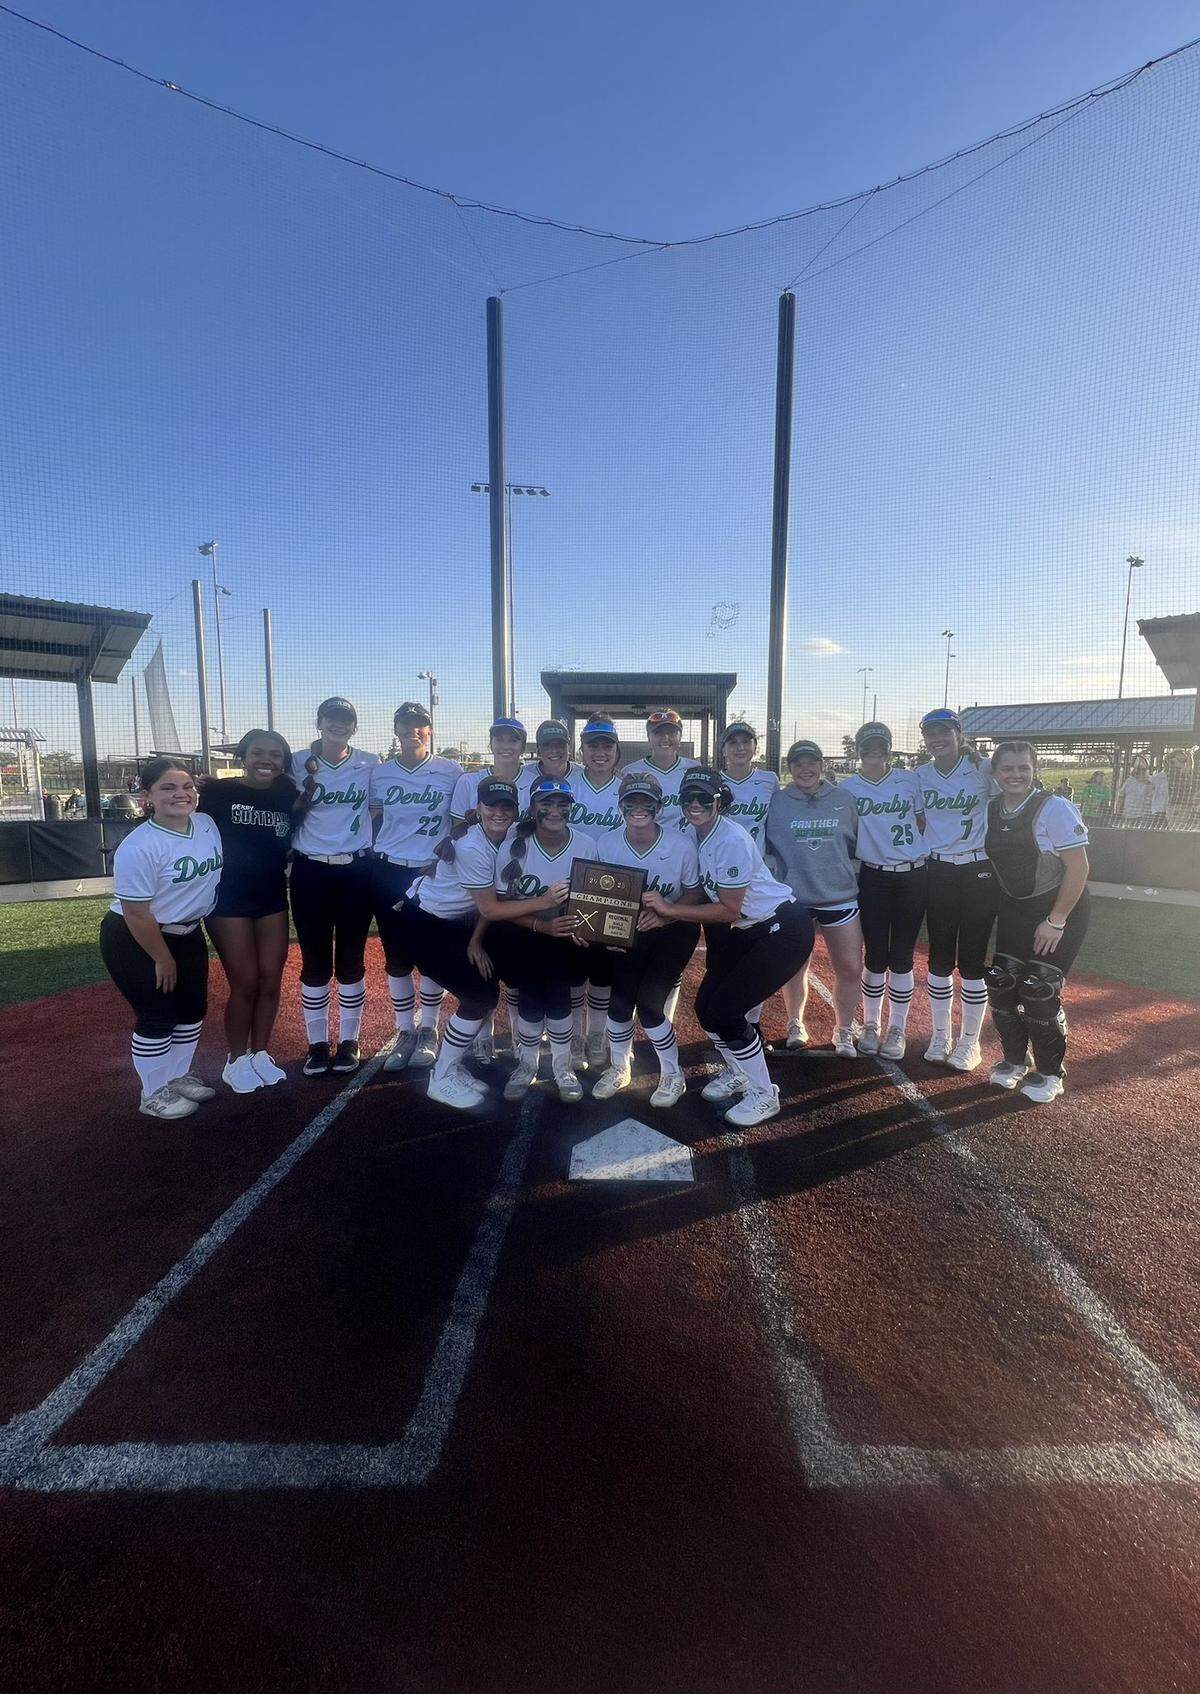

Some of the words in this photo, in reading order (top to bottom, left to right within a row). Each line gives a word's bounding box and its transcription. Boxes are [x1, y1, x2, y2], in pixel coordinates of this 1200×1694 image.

[310, 782, 368, 811] Derby
[383, 784, 444, 812] Derby
[489, 783, 514, 794] DERBY
[231, 803, 255, 812] DERBY
[727, 796, 769, 822] erby
[856, 793, 911, 820] Derby
[922, 788, 980, 816] Derby
[350, 814, 361, 836] 4
[415, 815, 443, 837] 22
[570, 802, 624, 831] Derby
[790, 819, 840, 829] PANTHER
[890, 823, 914, 847] 25
[960, 818, 973, 841] 7
[172, 846, 223, 884] Derb
[576, 893, 633, 908] CHAMPIONS
